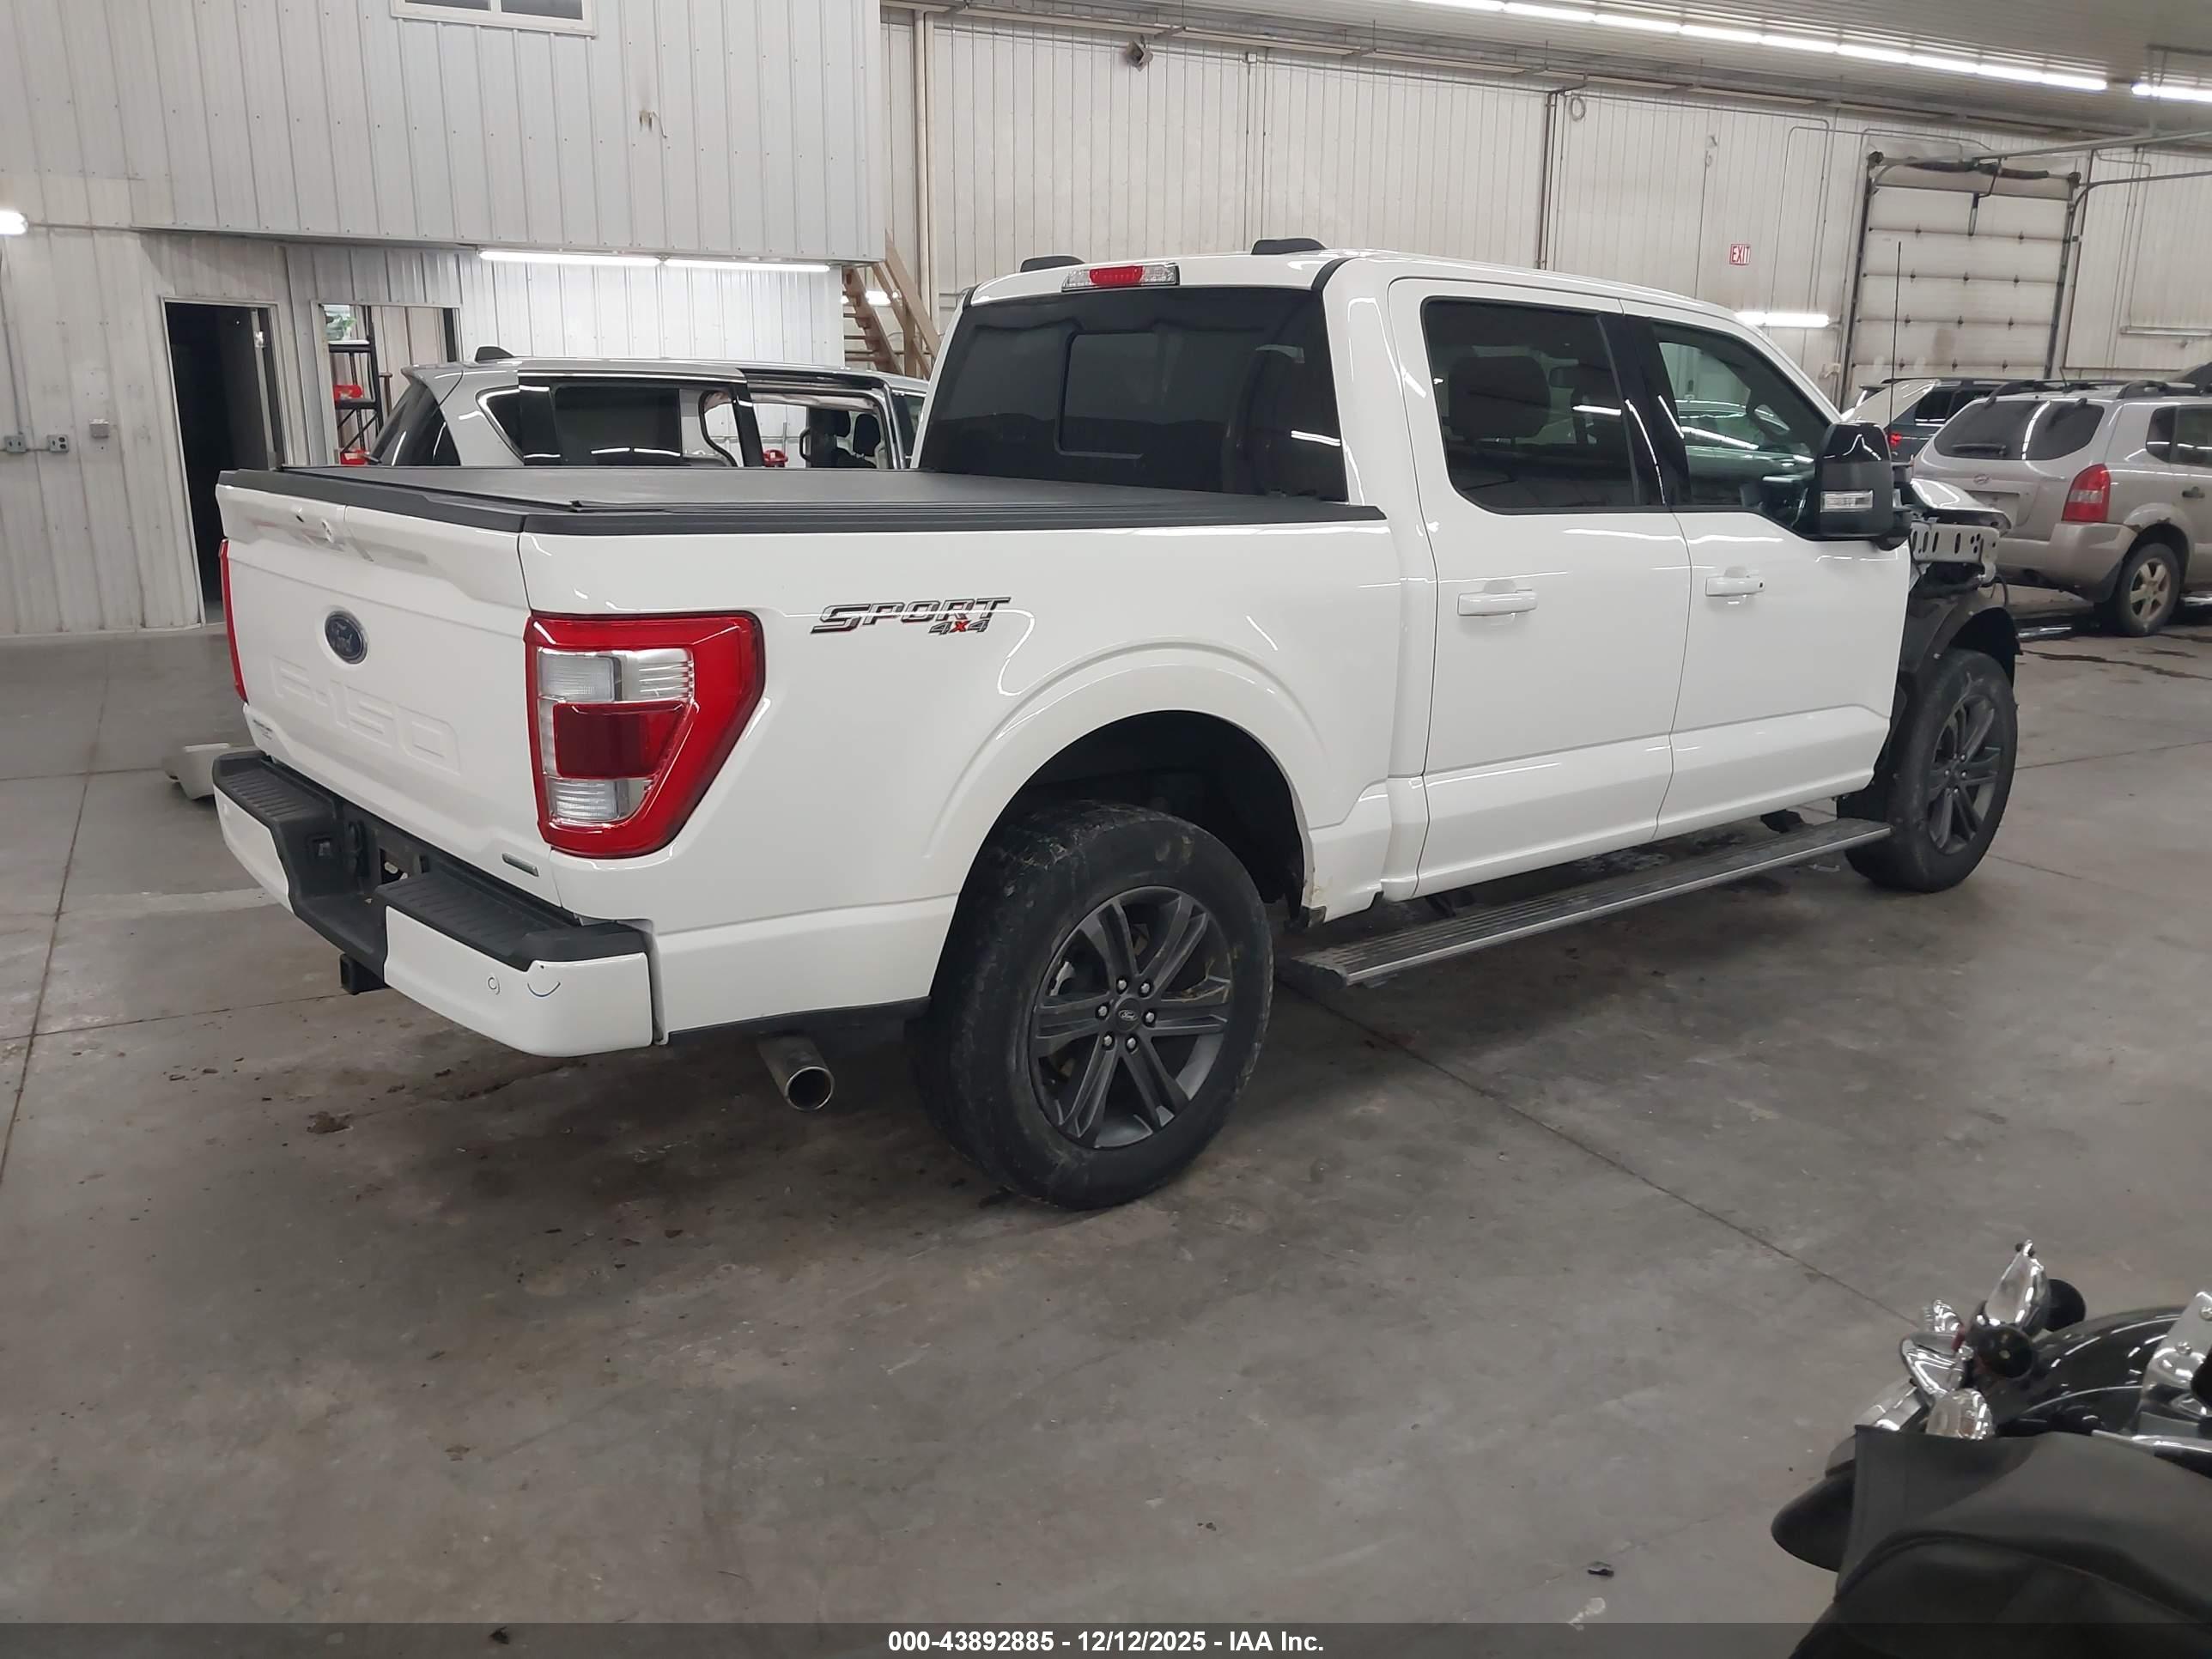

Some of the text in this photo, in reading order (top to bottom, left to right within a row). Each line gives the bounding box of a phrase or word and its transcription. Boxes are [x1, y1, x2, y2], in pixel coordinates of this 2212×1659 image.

[1731, 245, 1750, 264] EXIT
[811, 597, 1012, 634] SPORT
[270, 654, 461, 775] F-150
